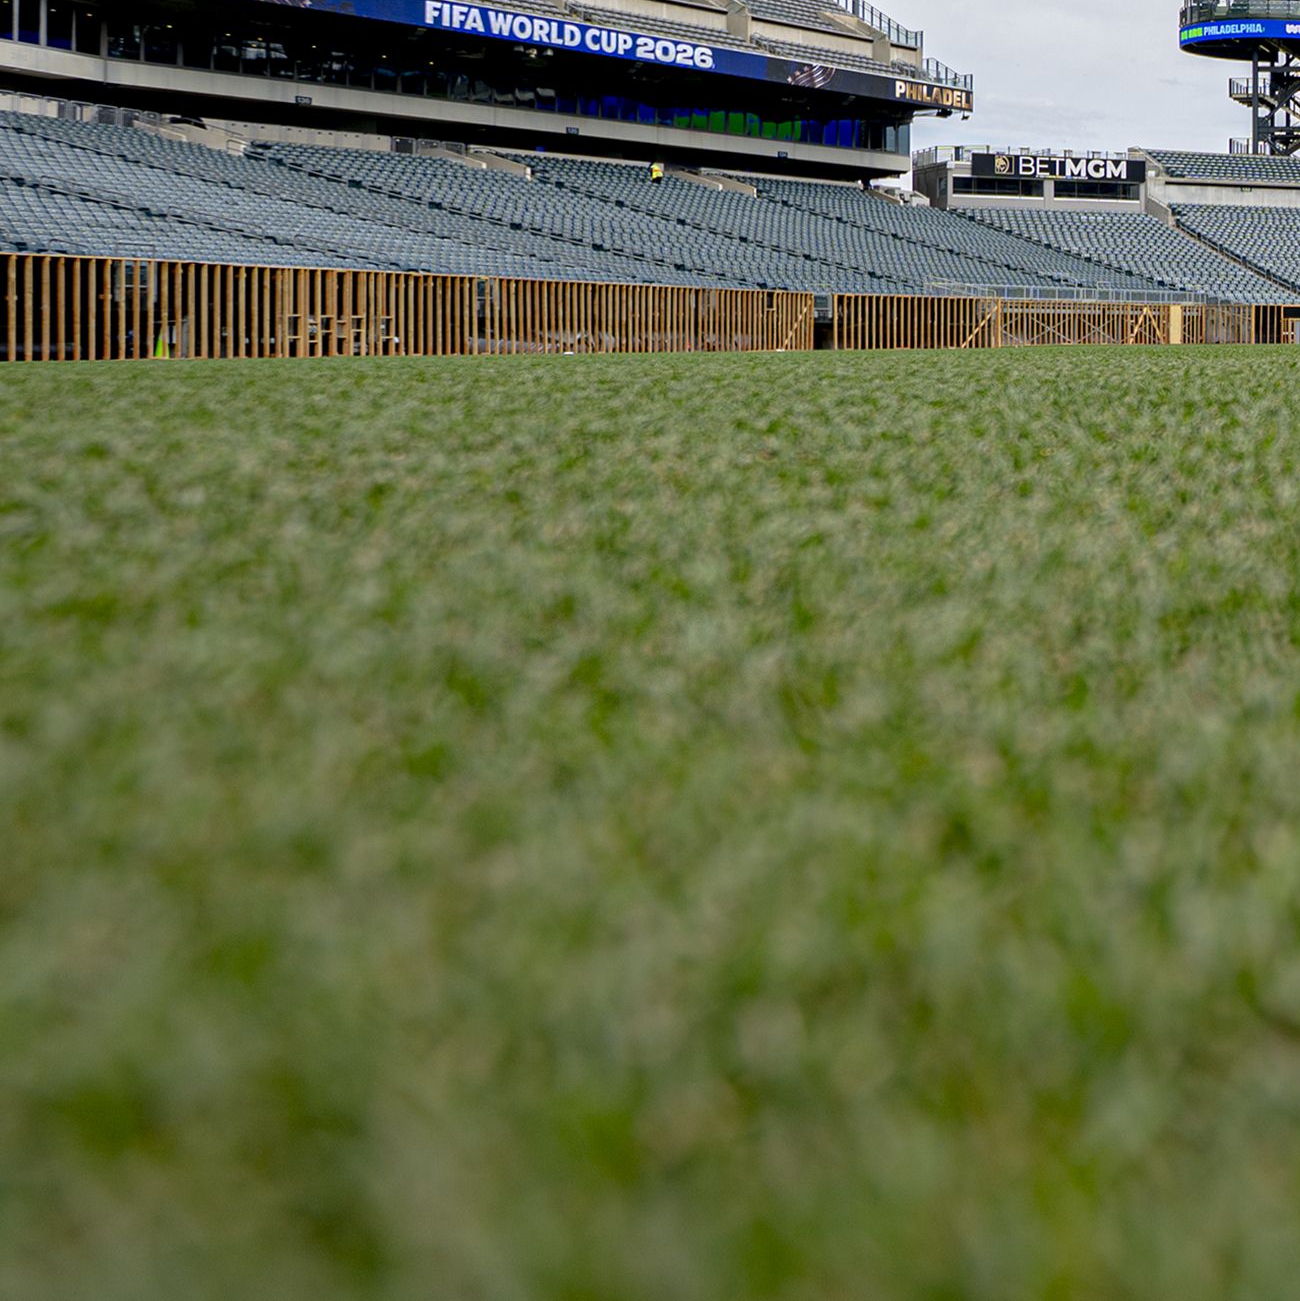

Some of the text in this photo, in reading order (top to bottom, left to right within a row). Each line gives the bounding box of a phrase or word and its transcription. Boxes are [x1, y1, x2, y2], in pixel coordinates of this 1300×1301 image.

[425, 0, 713, 70] FIFA WORLD CUP 2026
[1204, 24, 1263, 36] PHILADELPHIA
[1018, 156, 1127, 179] BETMGM
